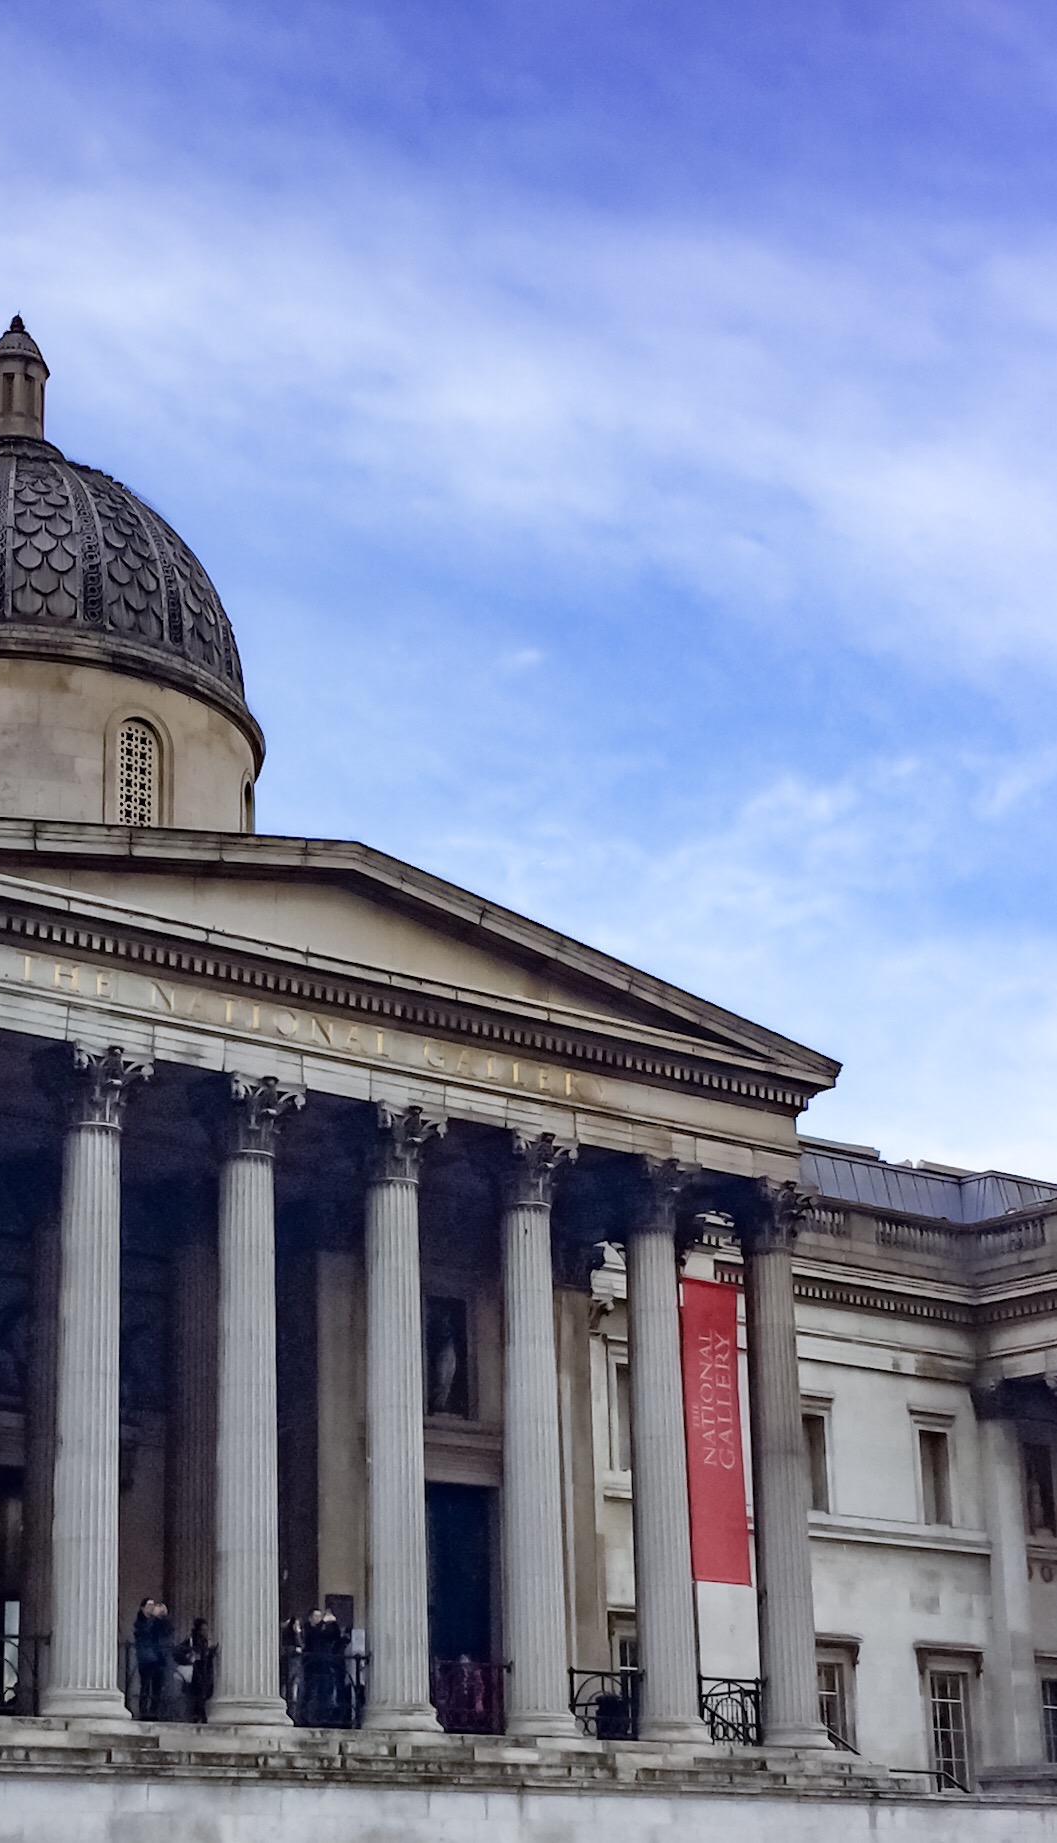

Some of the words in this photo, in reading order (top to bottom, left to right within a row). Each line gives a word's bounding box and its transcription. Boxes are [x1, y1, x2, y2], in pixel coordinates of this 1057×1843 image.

[16, 950, 114, 998] THE
[150, 980, 391, 1058] NATIONAL
[697, 1329, 718, 1467] NATIONAL
[714, 1331, 736, 1470] GALLERY
